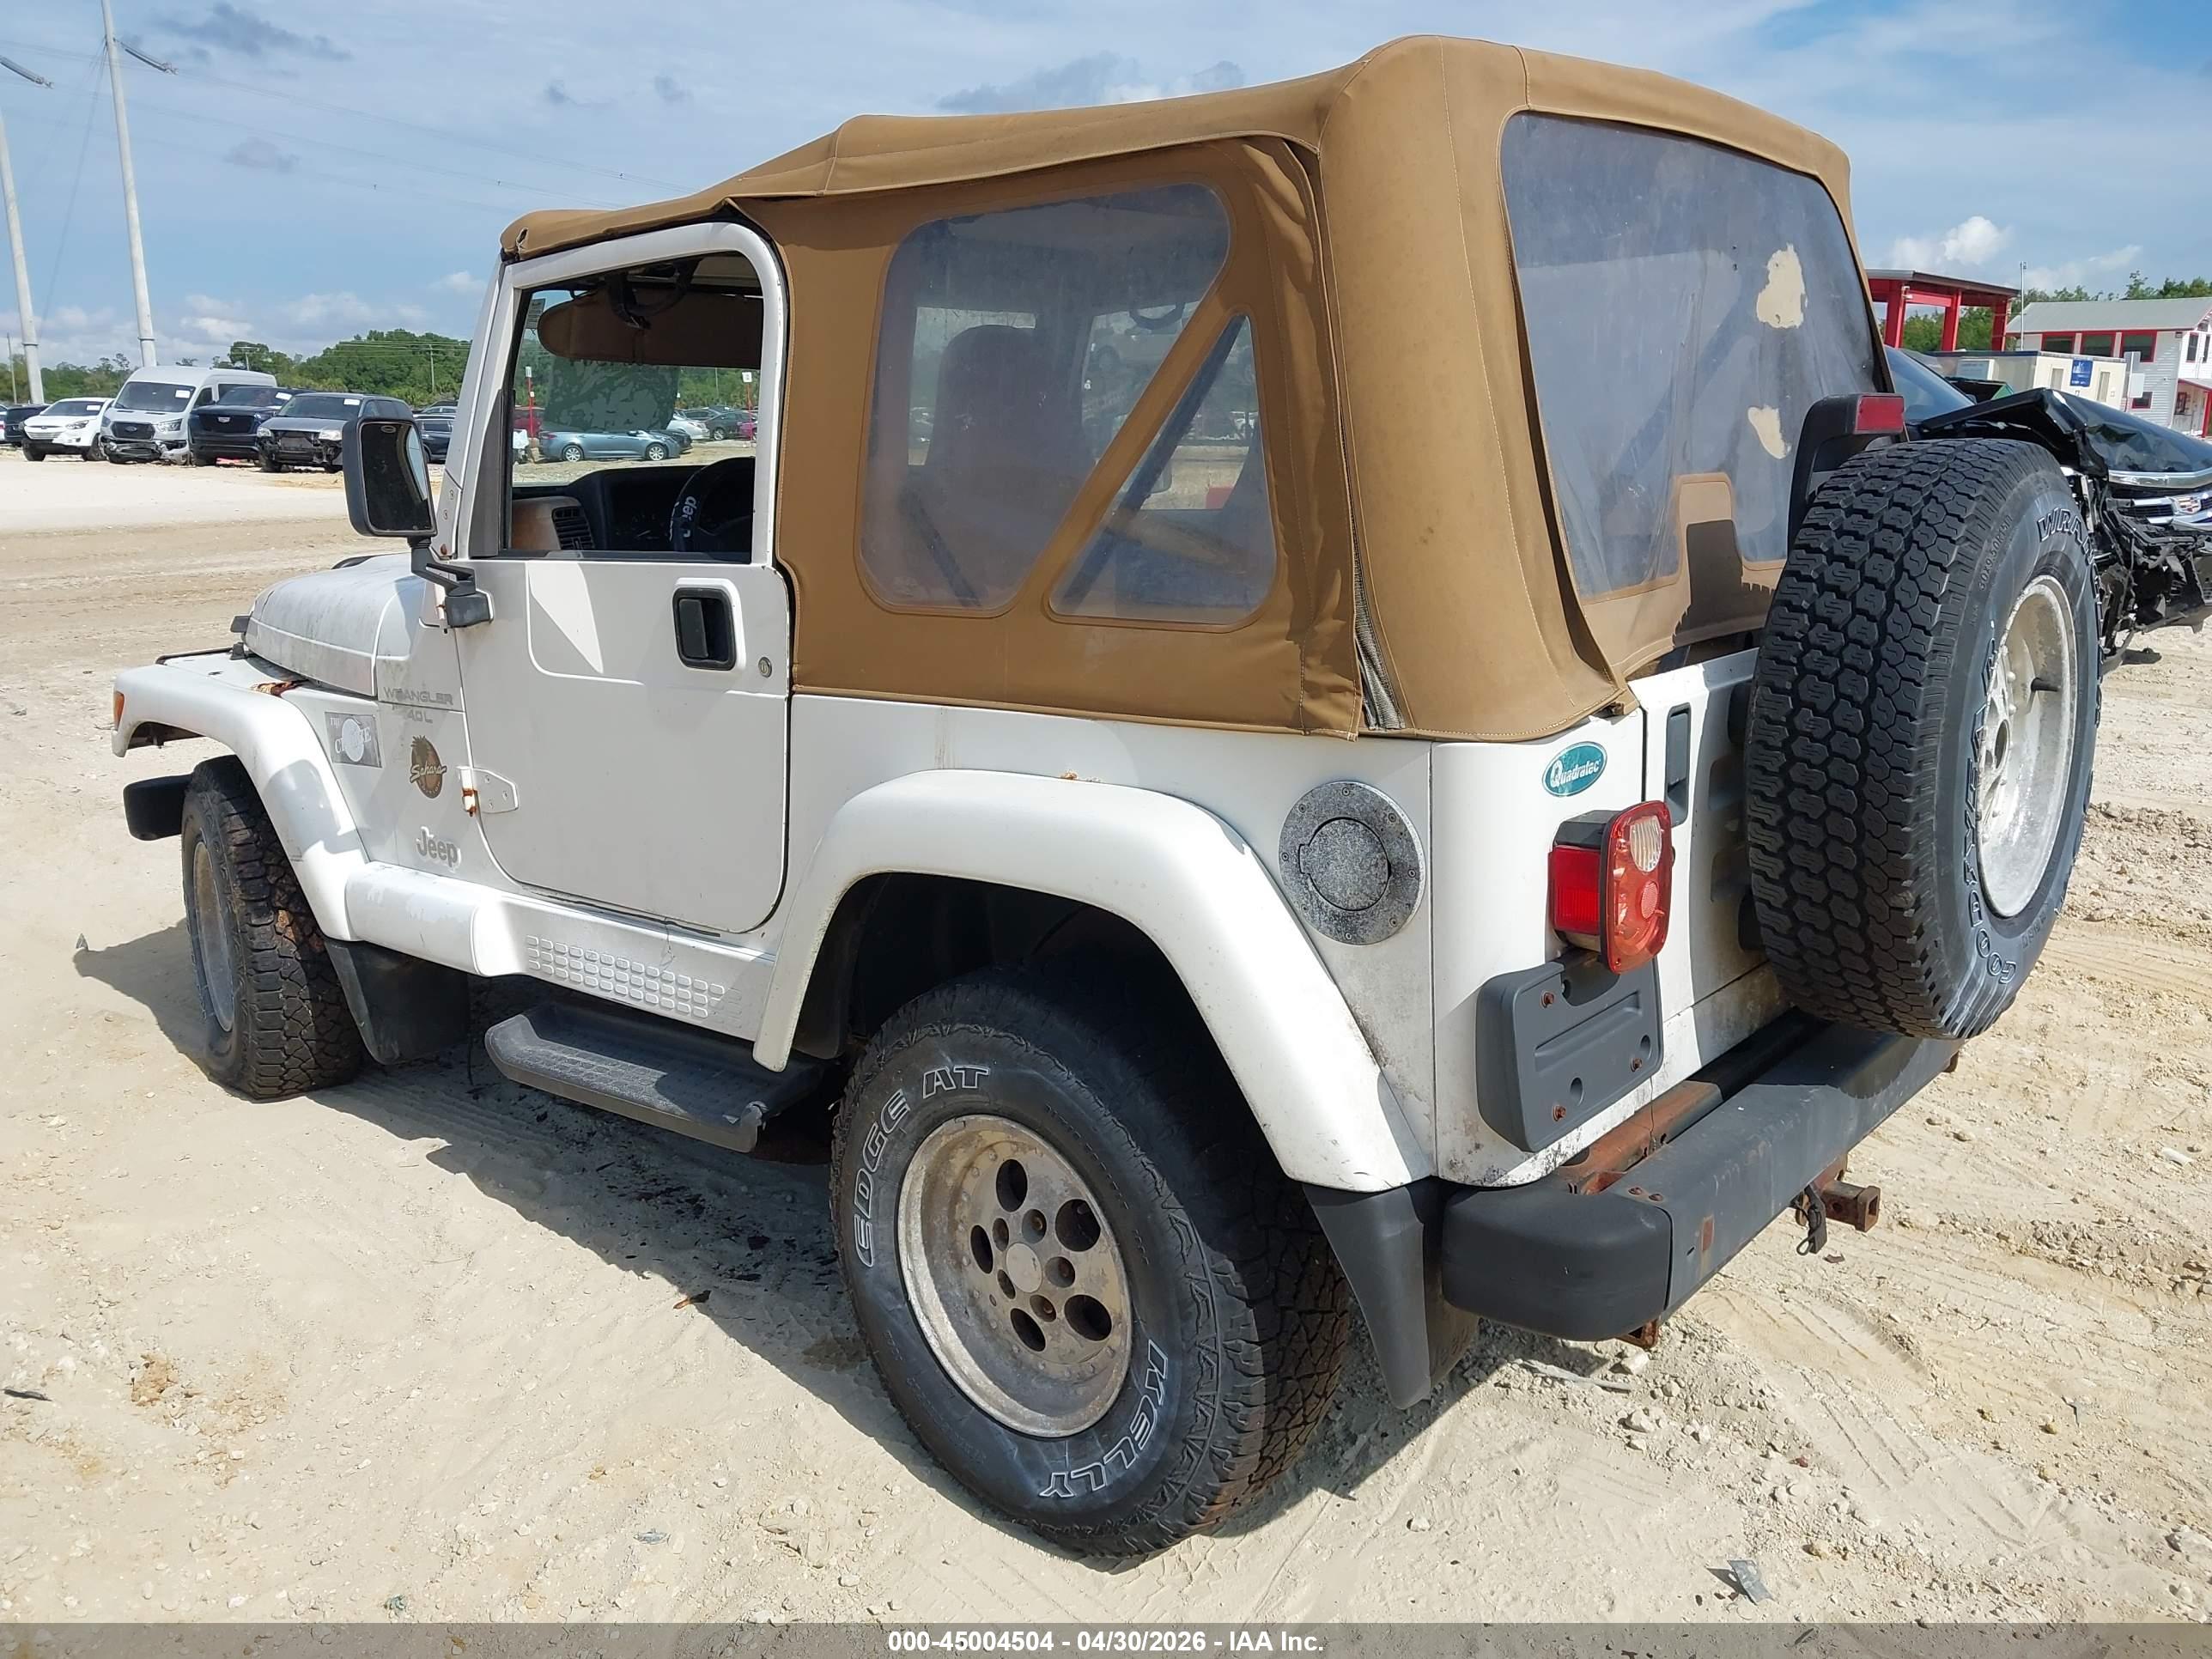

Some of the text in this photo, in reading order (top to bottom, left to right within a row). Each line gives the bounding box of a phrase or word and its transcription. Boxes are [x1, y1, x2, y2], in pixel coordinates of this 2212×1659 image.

[410, 760, 447, 783] Sahara
[1549, 757, 1601, 788] Quadratec
[416, 826, 461, 868] Jeep
[853, 1064, 989, 1268] EDGE AT
[1039, 1339, 1169, 1499] KELLY
